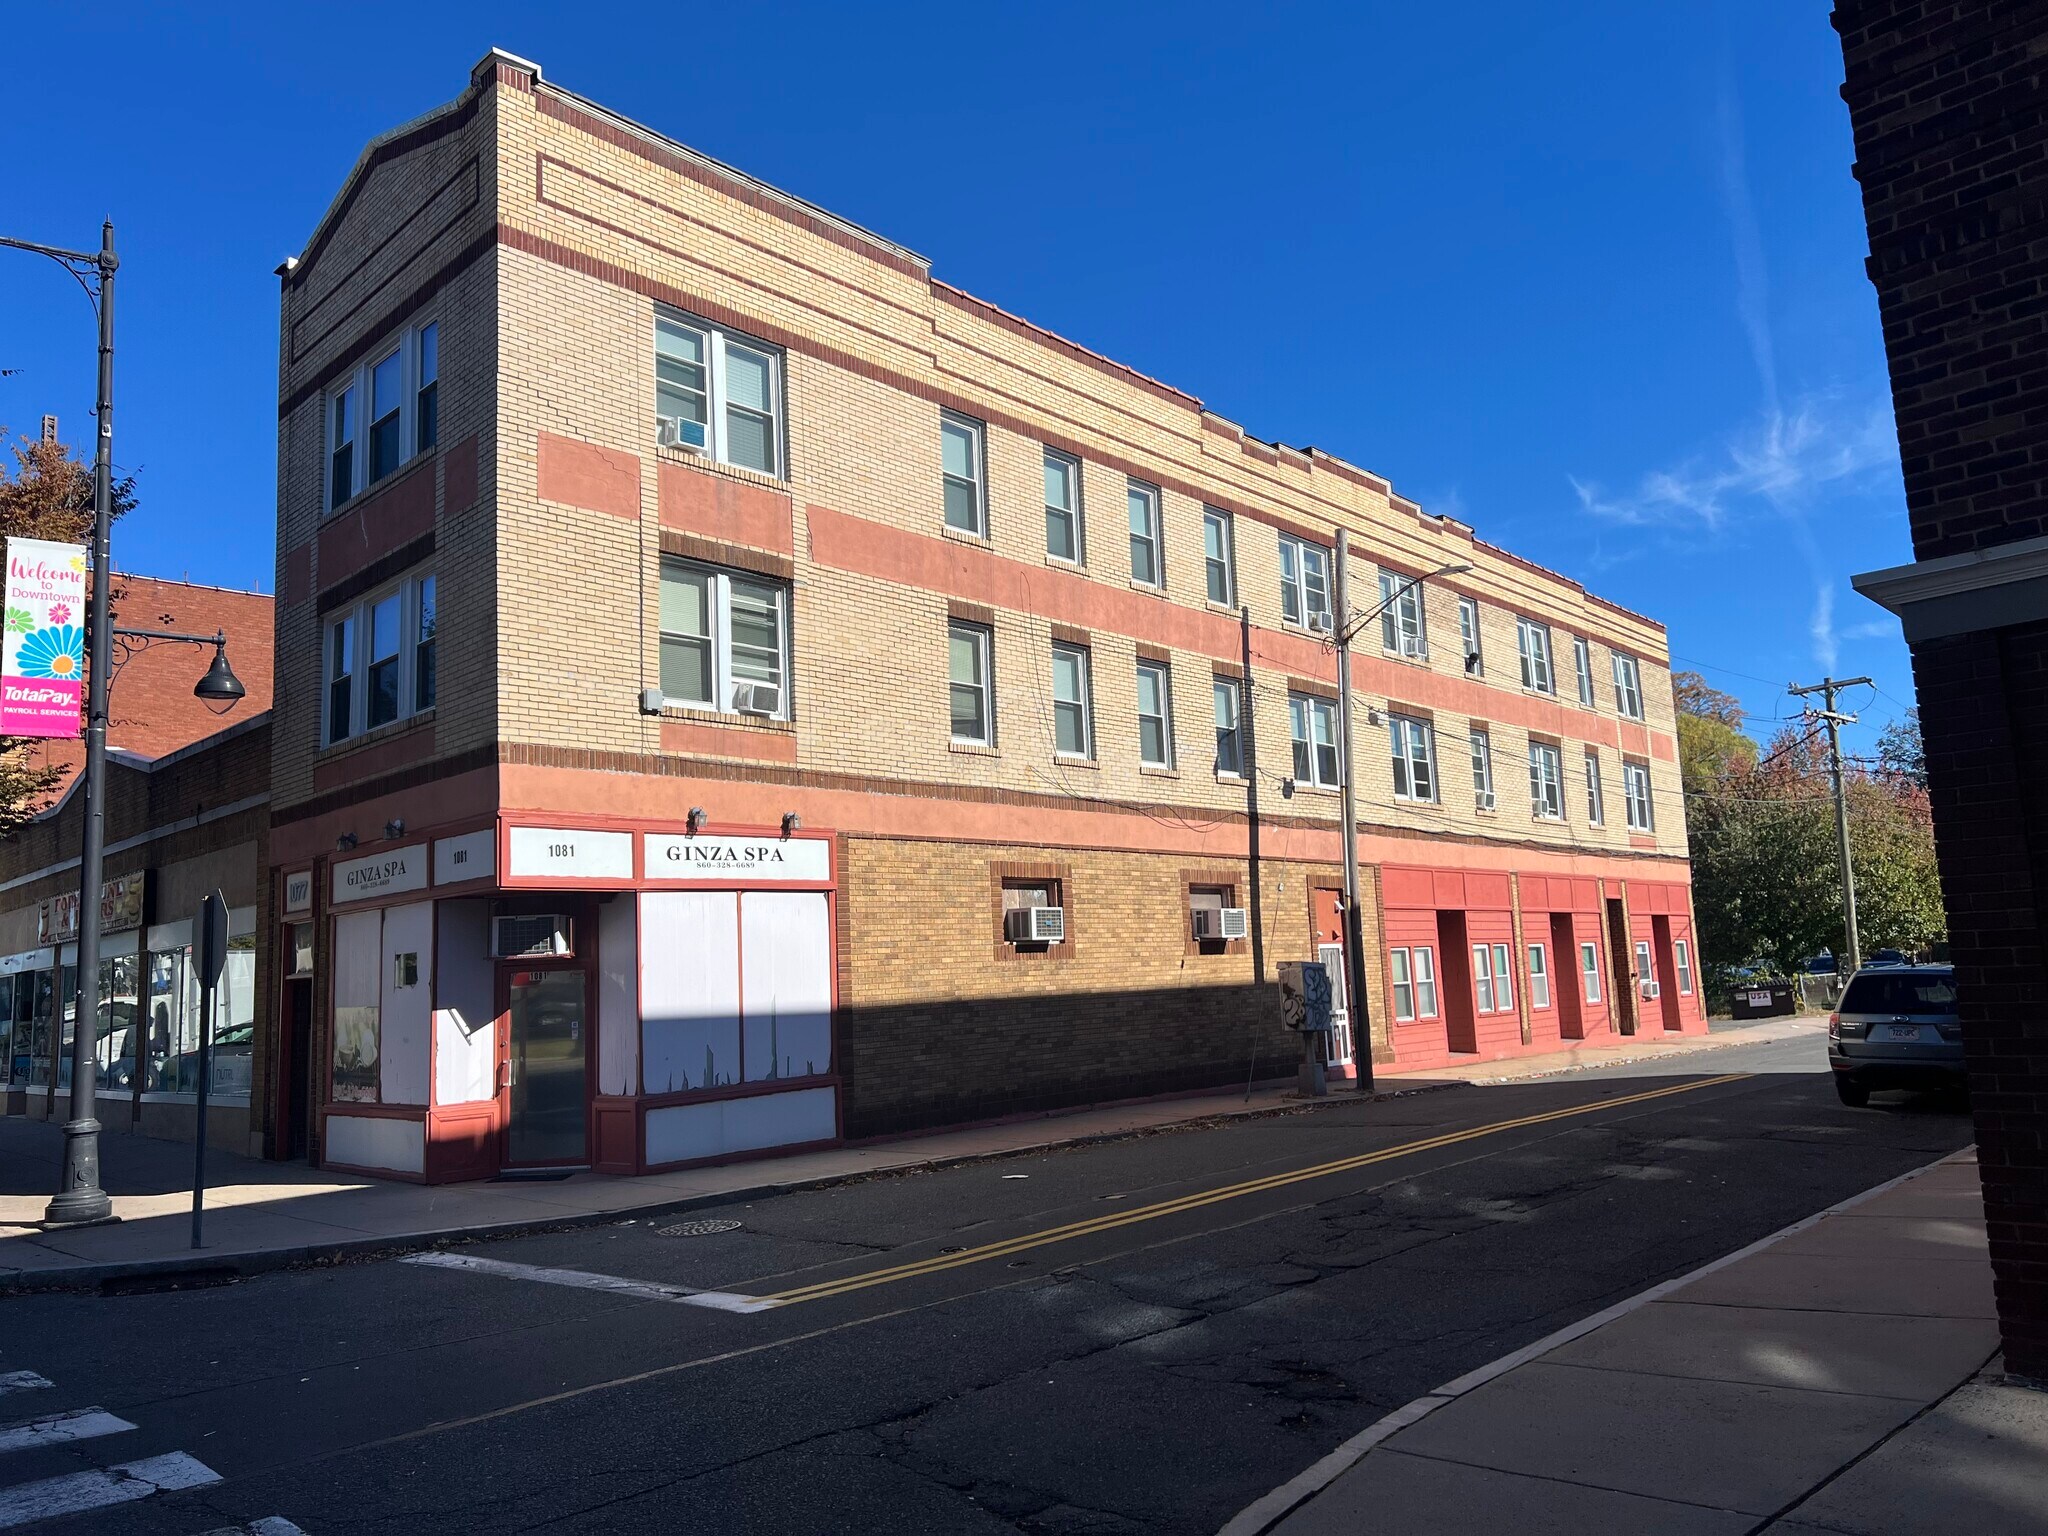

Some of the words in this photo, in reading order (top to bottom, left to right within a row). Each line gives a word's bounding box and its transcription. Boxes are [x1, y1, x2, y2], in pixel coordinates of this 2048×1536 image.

[11, 557, 83, 583] Welcome
[41, 579, 53, 590] to
[12, 587, 81, 604] Downtown
[5, 686, 73, 707] TotalPay
[4, 706, 38, 715] PAYROLL
[40, 709, 79, 717] SERVICES
[453, 850, 467, 864] 1081
[548, 844, 575, 858] 1081
[666, 845, 737, 862] GINZA
[744, 847, 784, 863] SPA
[347, 866, 381, 886] GINZA
[384, 859, 407, 879] SPA
[530, 972, 547, 980] 1081
[1750, 992, 1769, 1000] USA
